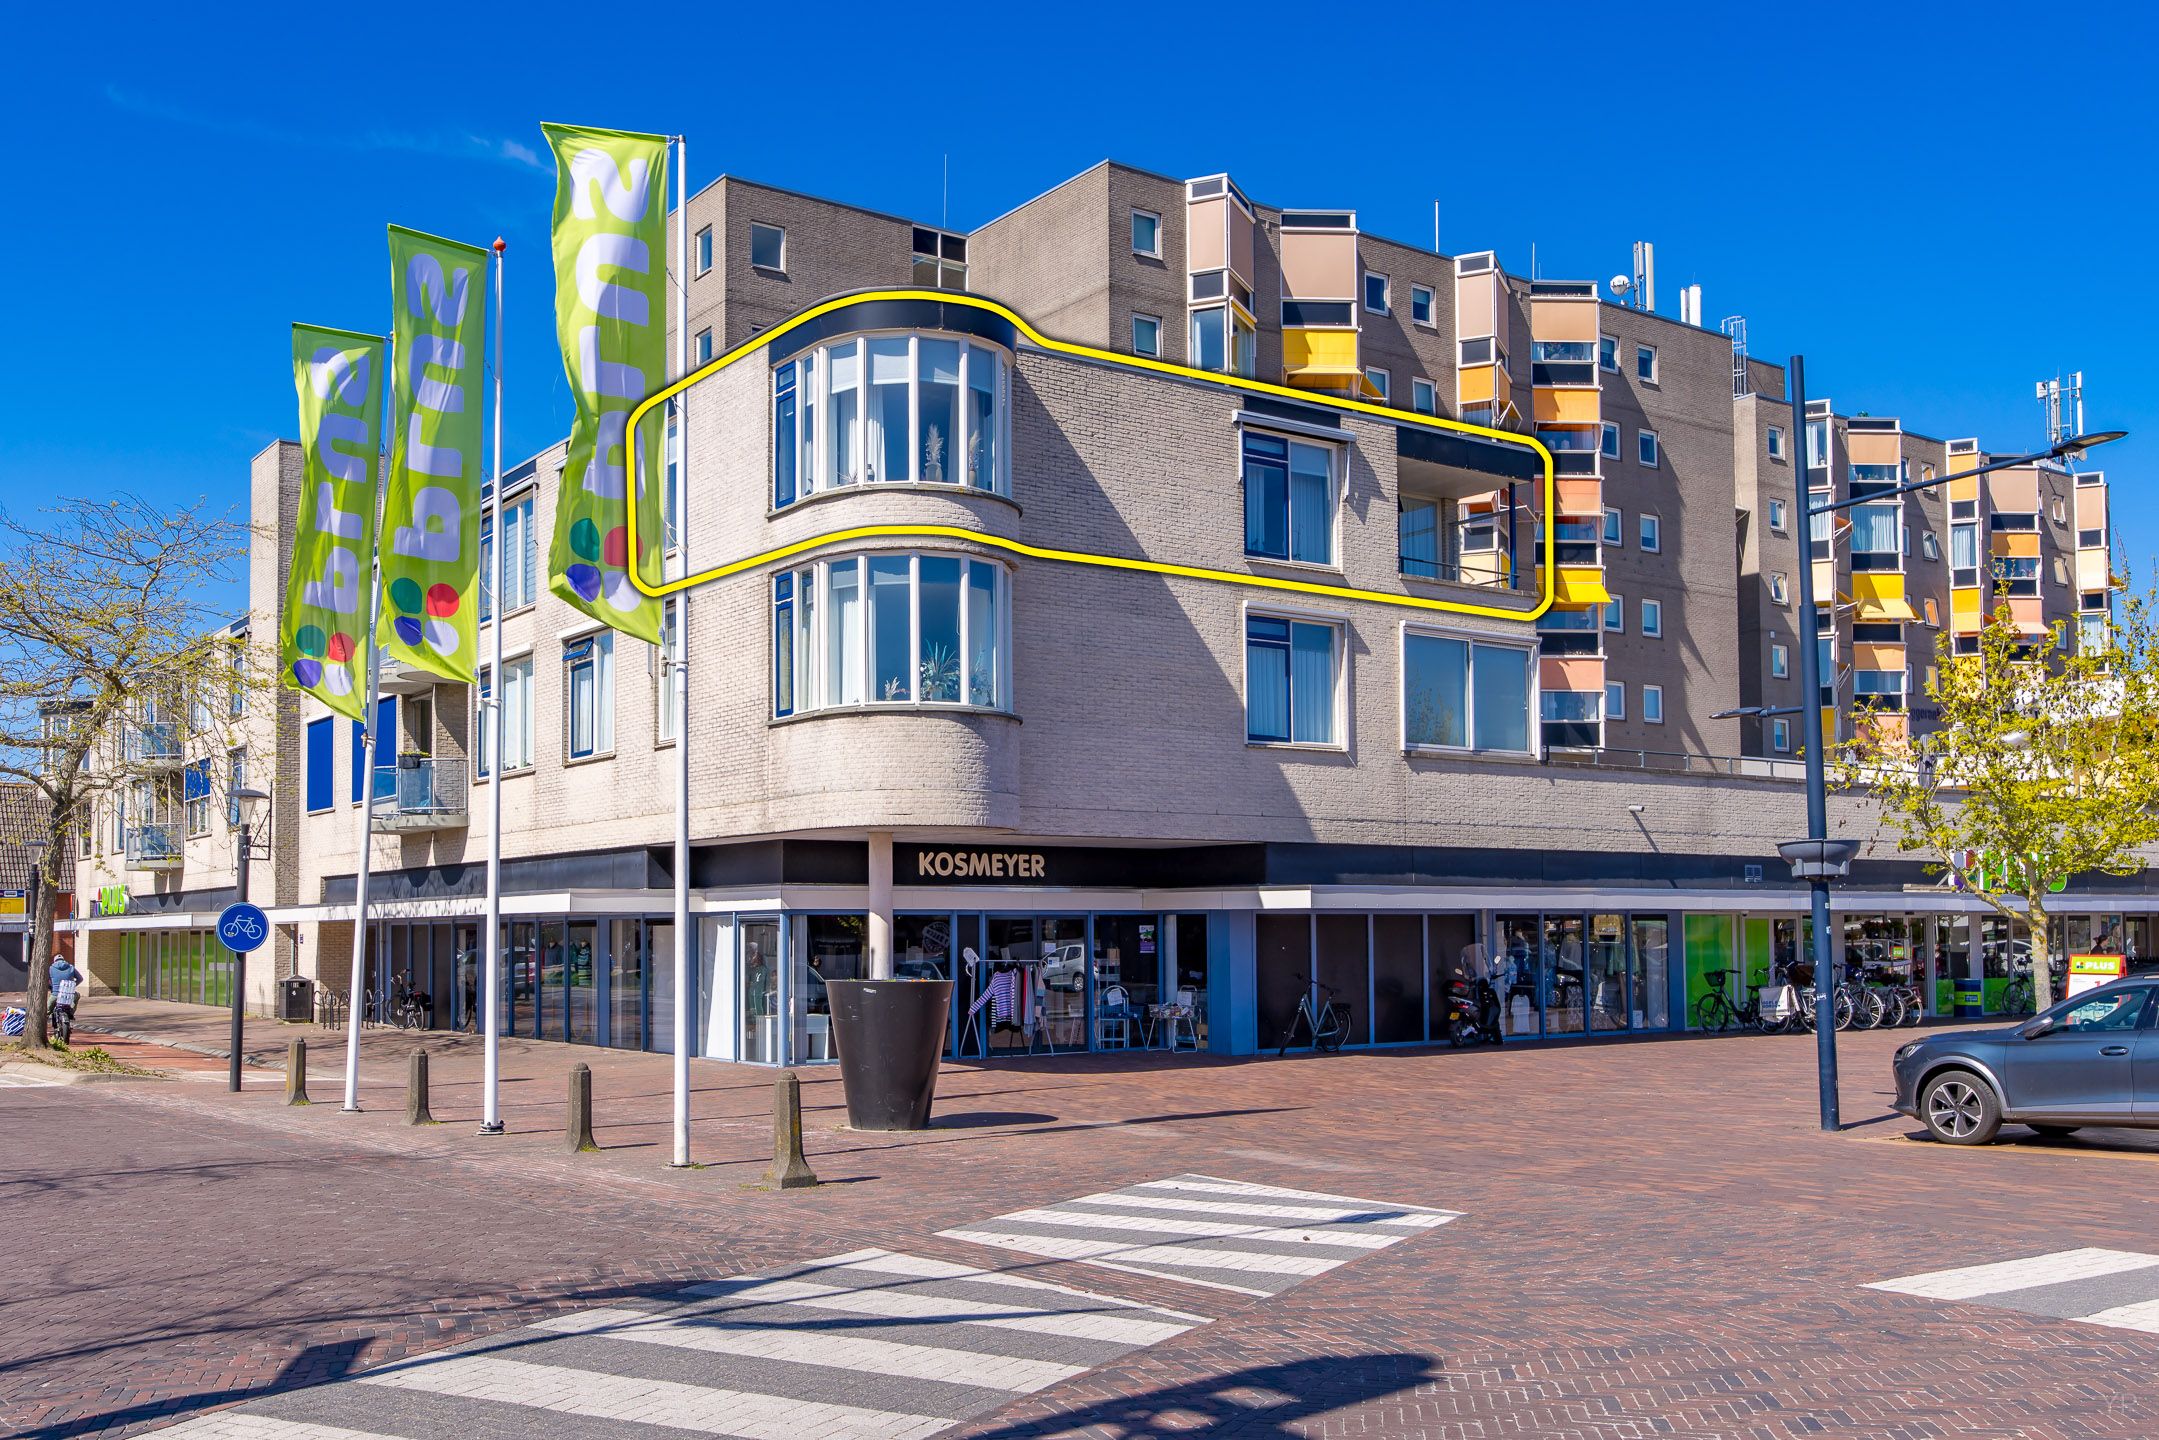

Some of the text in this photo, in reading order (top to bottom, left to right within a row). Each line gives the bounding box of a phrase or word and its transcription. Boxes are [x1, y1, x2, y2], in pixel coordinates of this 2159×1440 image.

[919, 852, 1045, 877] KOSMEYER
[102, 884, 126, 916] PLUS
[2085, 961, 2115, 970] PLUS
